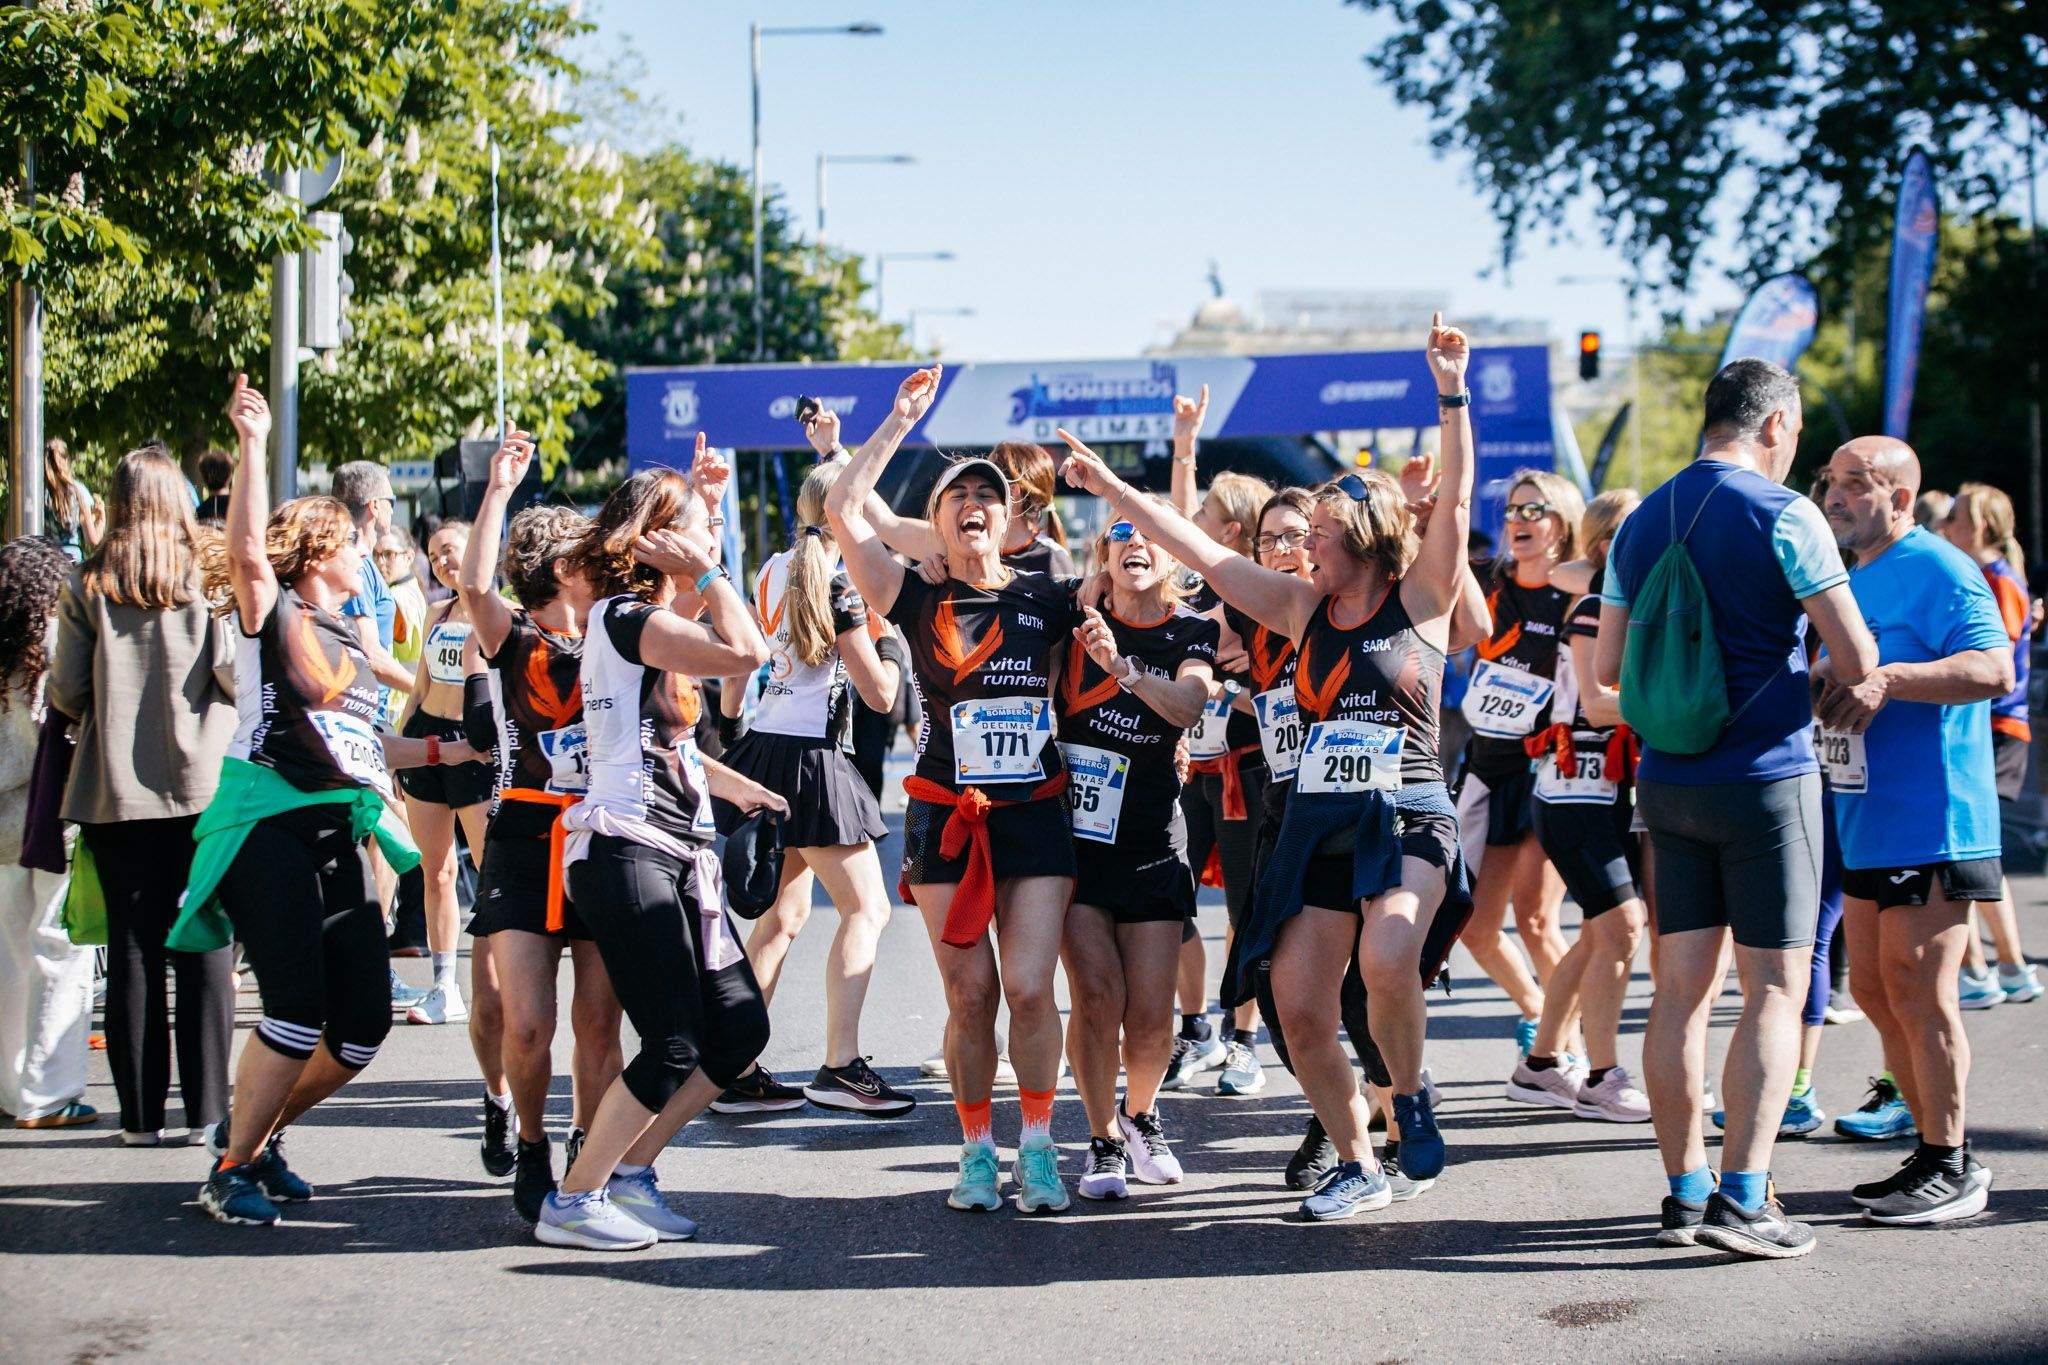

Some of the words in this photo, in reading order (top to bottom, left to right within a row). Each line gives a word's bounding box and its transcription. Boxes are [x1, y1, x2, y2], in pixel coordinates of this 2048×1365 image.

[1035, 419, 1171, 437] DECIMAS
[1018, 613, 1043, 630] RUTH
[1362, 638, 1392, 652] SARA
[990, 656, 1031, 671] vital
[982, 674, 1047, 687] runners
[263, 682, 280, 714] vital
[350, 686, 379, 704] vital
[1339, 690, 1376, 708] vital
[986, 708, 1032, 717] BOMBEROS
[1337, 710, 1400, 721] runners
[1479, 694, 1525, 719] 1293
[982, 722, 1033, 731] DECIMAS
[1099, 707, 1140, 730] vital
[505, 719, 522, 751] vital
[1089, 718, 1161, 744] runners
[1337, 731, 1384, 741] BOMBE
[981, 731, 1029, 757] 1771
[1328, 744, 1379, 754] DECIMAS
[1323, 755, 1372, 783] 290
[1553, 757, 1602, 780] 173
